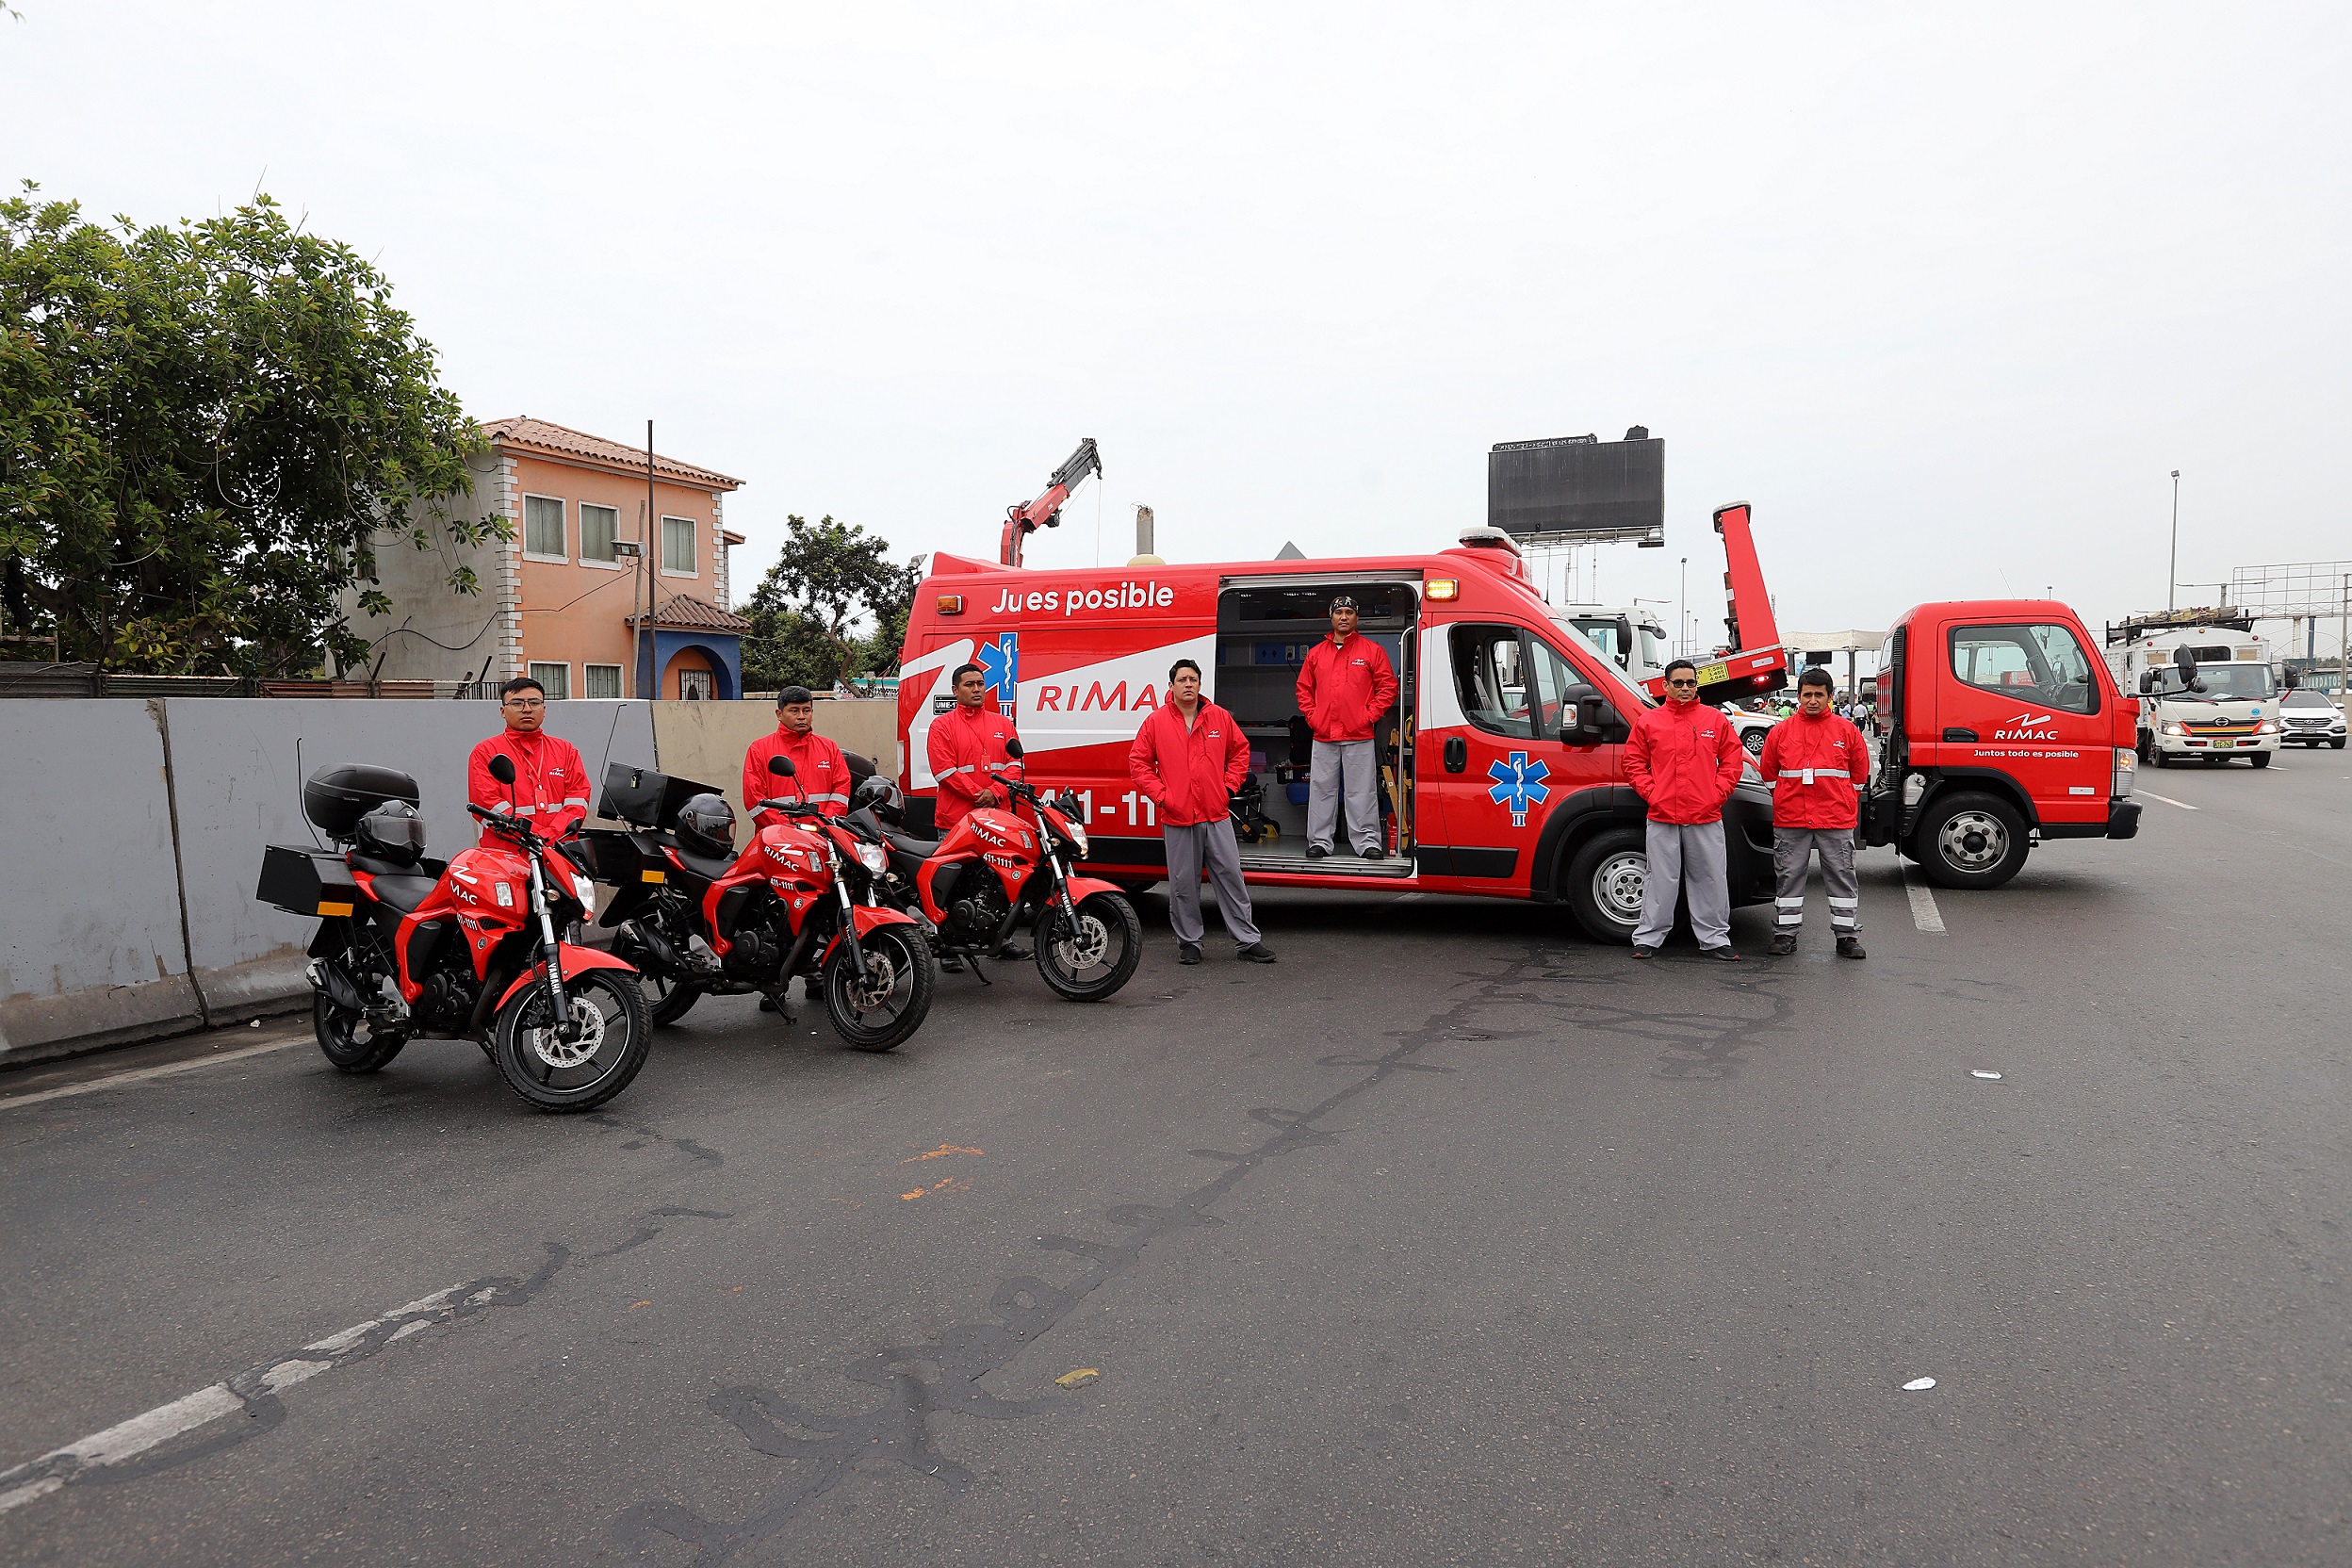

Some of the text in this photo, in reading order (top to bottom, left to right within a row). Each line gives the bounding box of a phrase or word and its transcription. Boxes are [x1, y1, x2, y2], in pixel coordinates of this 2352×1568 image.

[1065, 580, 1174, 616] posible
[1036, 680, 1171, 711] RIMA
[1994, 728, 2059, 740] RIMAC
[1973, 749, 2006, 758] Juntos
[2045, 750, 2080, 760] posible
[970, 822, 1006, 847] RIMAC
[764, 845, 799, 872] RIMAC
[982, 852, 1012, 869] 411-1111
[1060, 891, 1073, 916] YAMAHA
[547, 962, 561, 995] YAMAHA
